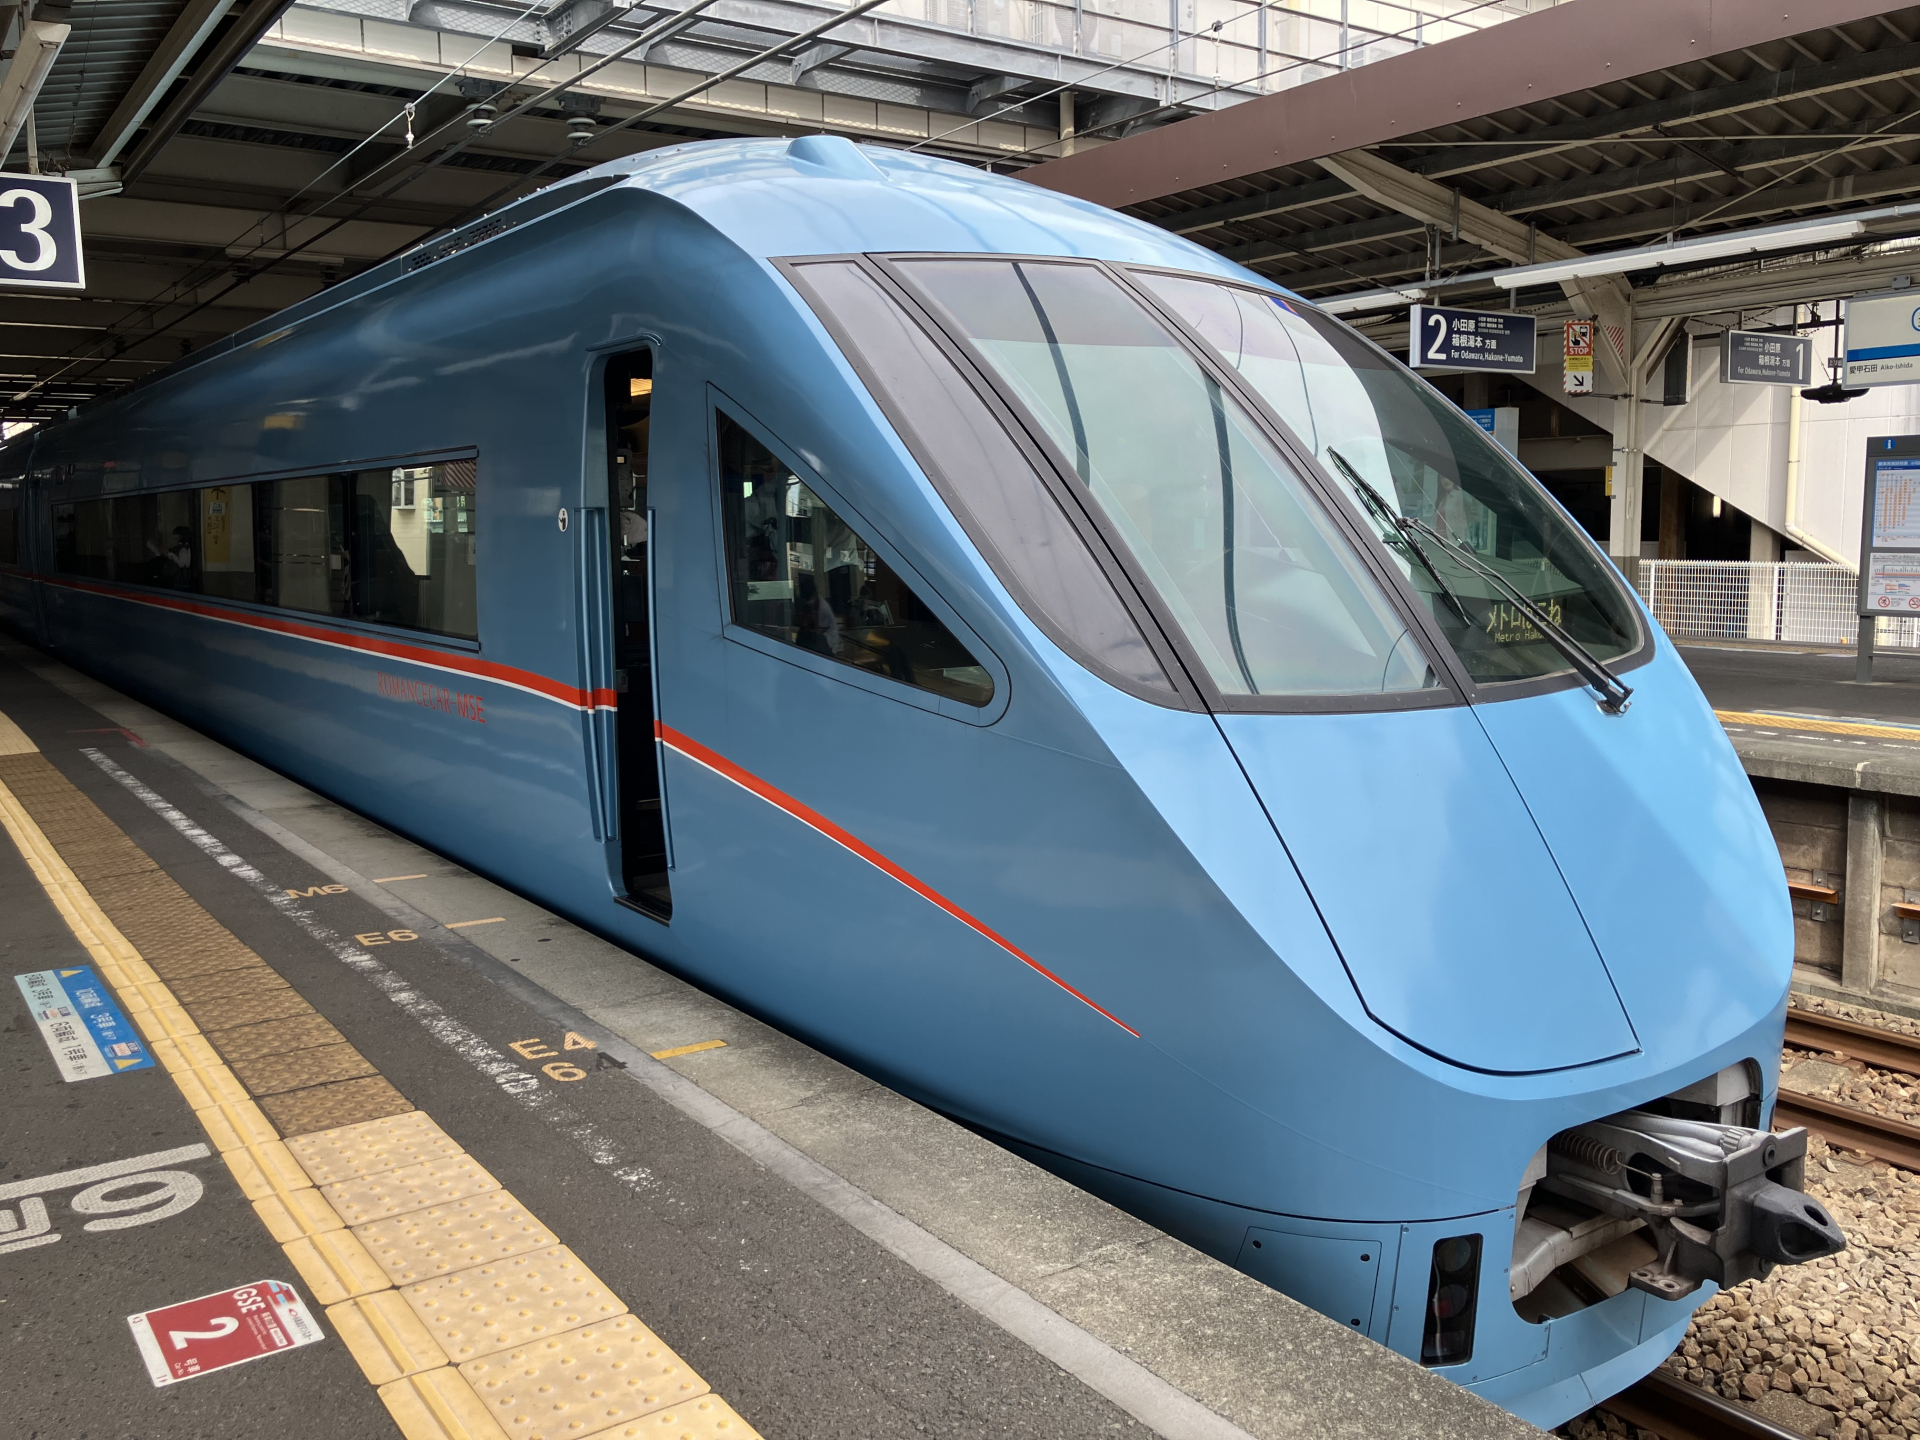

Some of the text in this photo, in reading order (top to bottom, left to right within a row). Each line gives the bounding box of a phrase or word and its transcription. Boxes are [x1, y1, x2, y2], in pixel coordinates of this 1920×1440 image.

[0, 189, 57, 272] 3
[1452, 318, 1476, 333] 小田原
[1427, 314, 1447, 360] 2
[1452, 334, 1497, 349] 箱根湯本 方面
[1451, 350, 1460, 359] For
[1569, 347, 1590, 355] STOP
[1764, 342, 1781, 353] 小田原
[1796, 343, 1804, 380] 1
[1849, 362, 1913, 374] 愛甲石田 Aiko-Ishida
[1494, 633, 1521, 643] Metro
[377, 671, 486, 724] ROMANCECAR-MSE
[285, 884, 350, 899] M6
[354, 929, 420, 946] E6
[541, 1062, 588, 1082] 6
[232, 1287, 266, 1314] GSE
[168, 1316, 239, 1350] 2
